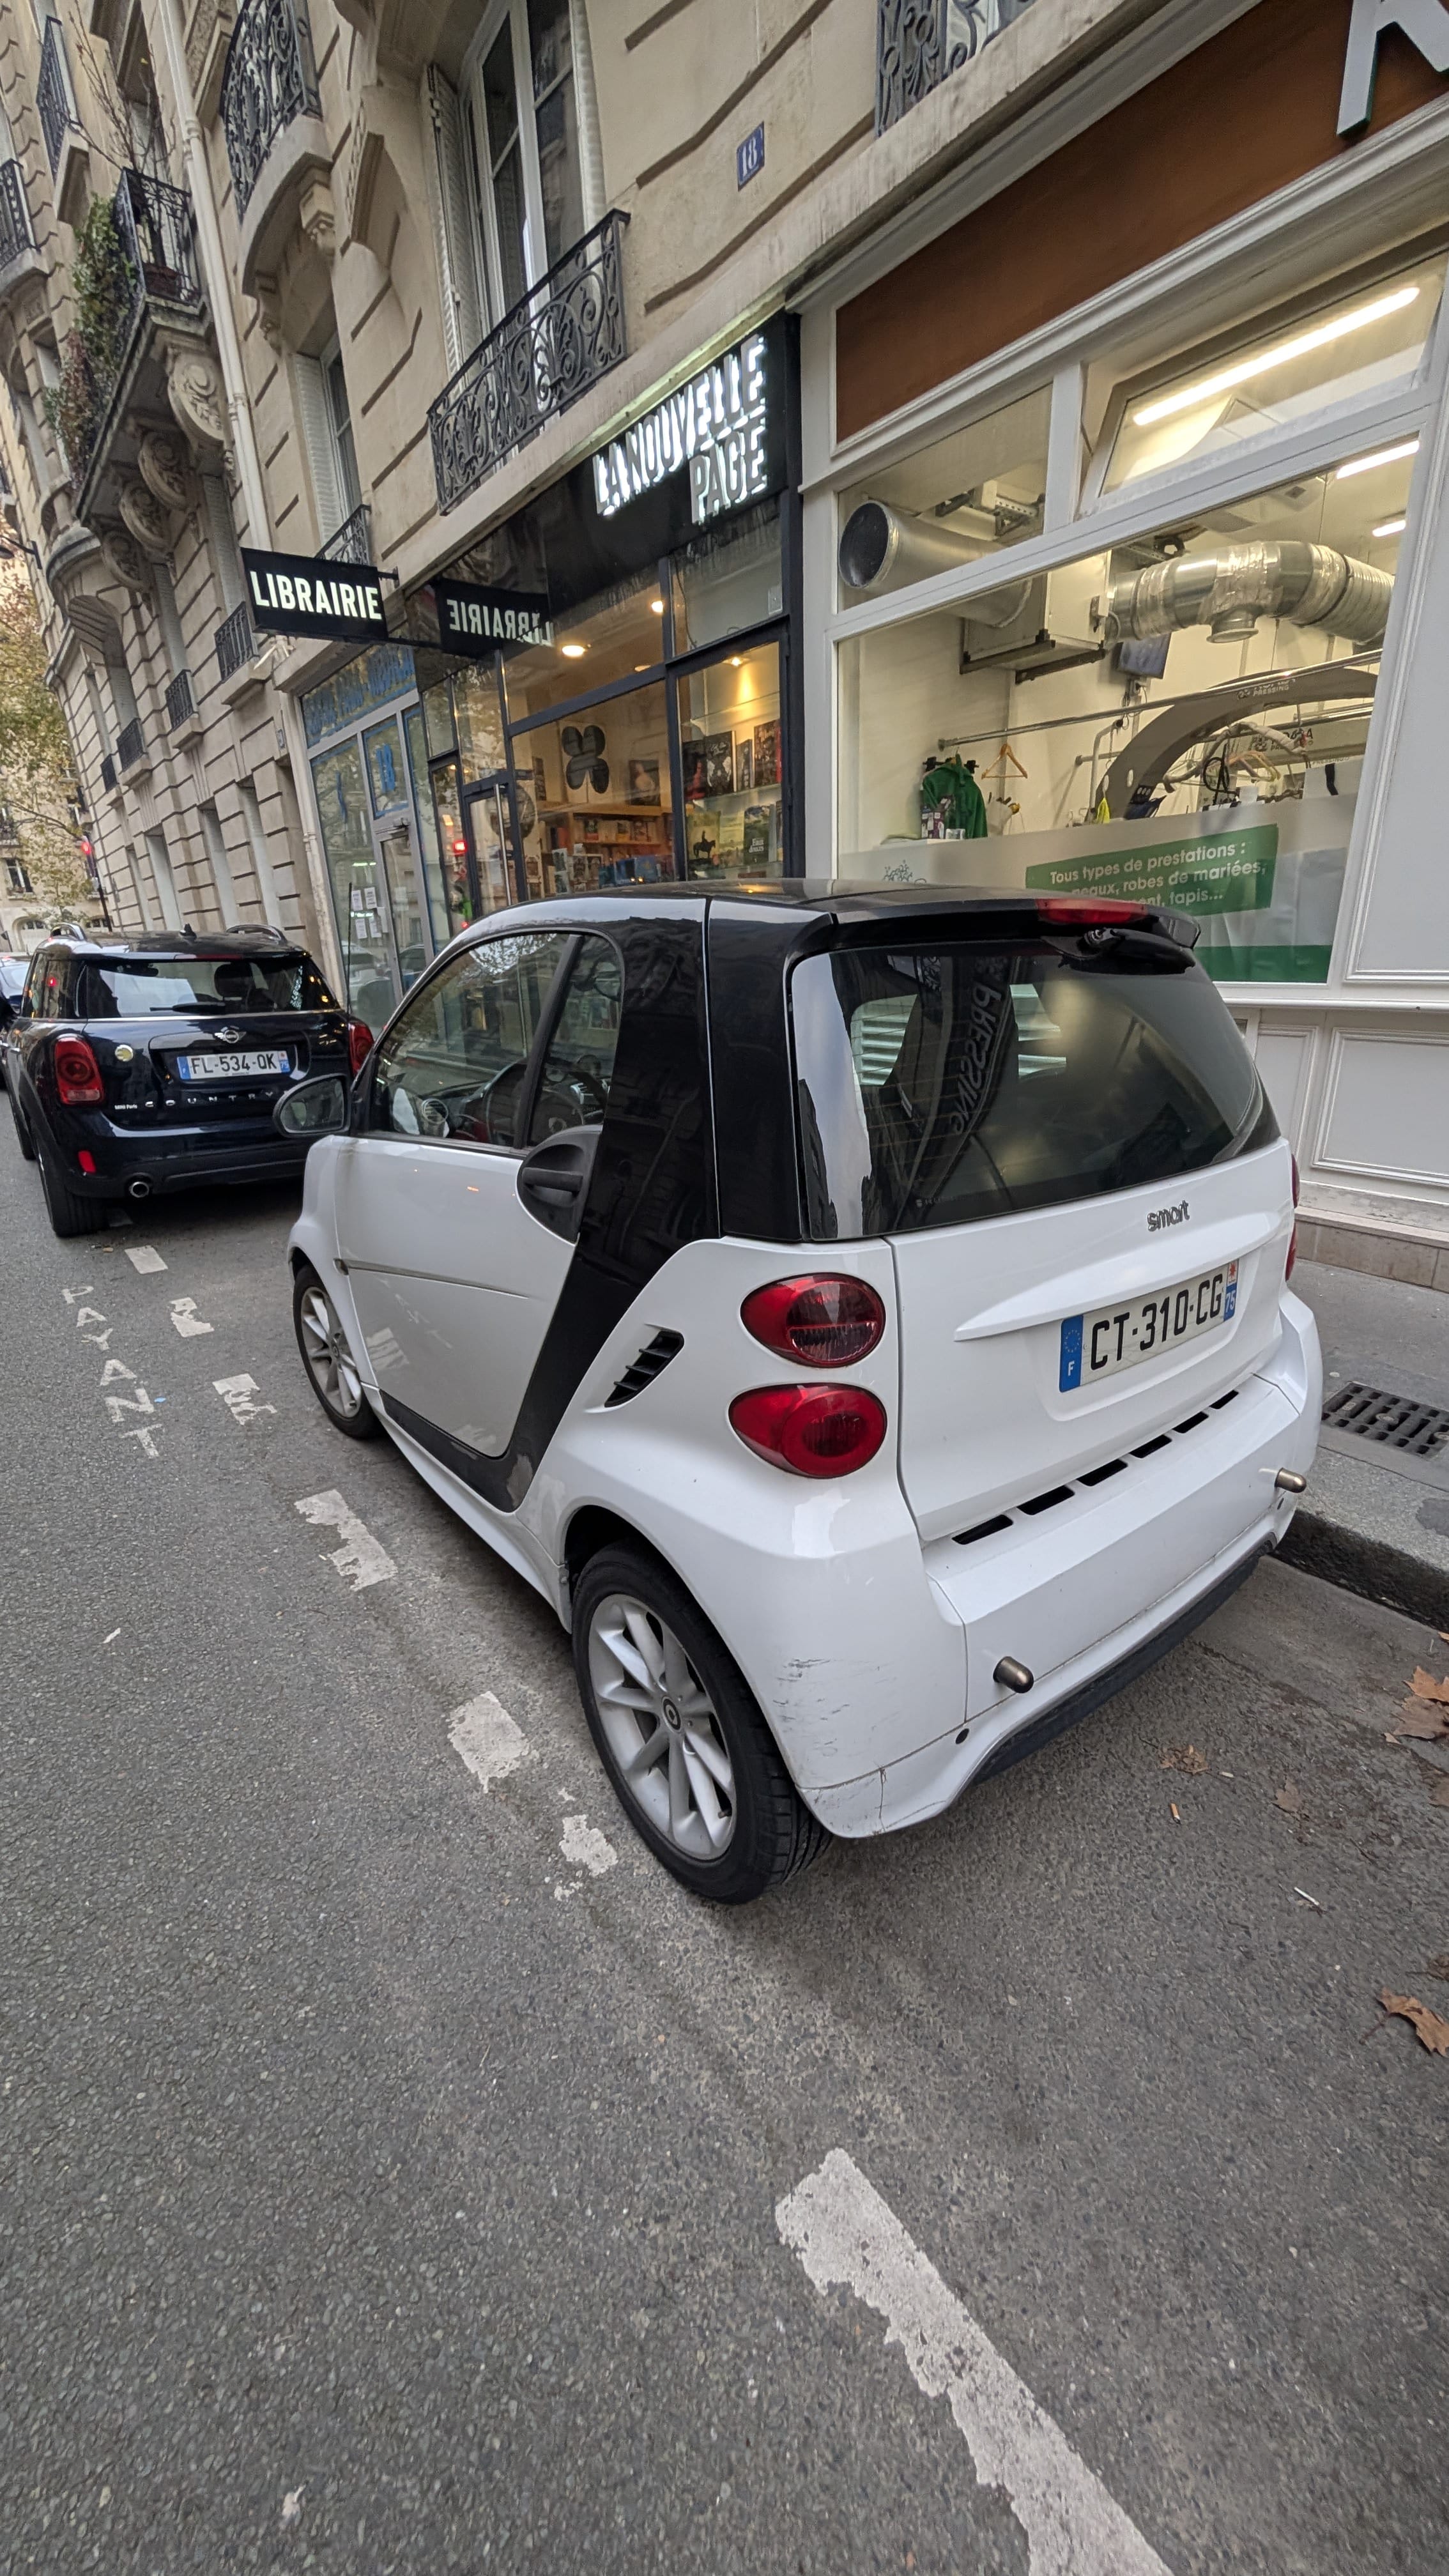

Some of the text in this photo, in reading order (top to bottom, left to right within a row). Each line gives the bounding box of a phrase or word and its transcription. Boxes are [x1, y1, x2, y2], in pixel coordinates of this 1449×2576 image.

[742, 137, 757, 177] 18
[592, 334, 766, 516] LA NOUVELLE
[689, 418, 767, 525] PAGE
[250, 571, 382, 620] LIBRAIRIE
[1050, 870, 1079, 885] Tous
[1082, 864, 1120, 882] types
[1123, 858, 1142, 873] de
[1147, 843, 1236, 870] prestations
[1123, 873, 1164, 893] robes
[1168, 870, 1188, 885] de
[1193, 859, 1266, 882] mariées,
[1170, 889, 1224, 910] tapis...
[1147, 1200, 1191, 1232] smart
[1068, 1273, 1236, 1377] F CT-310-CG 75
[61, 1285, 163, 1458] PAYANT
